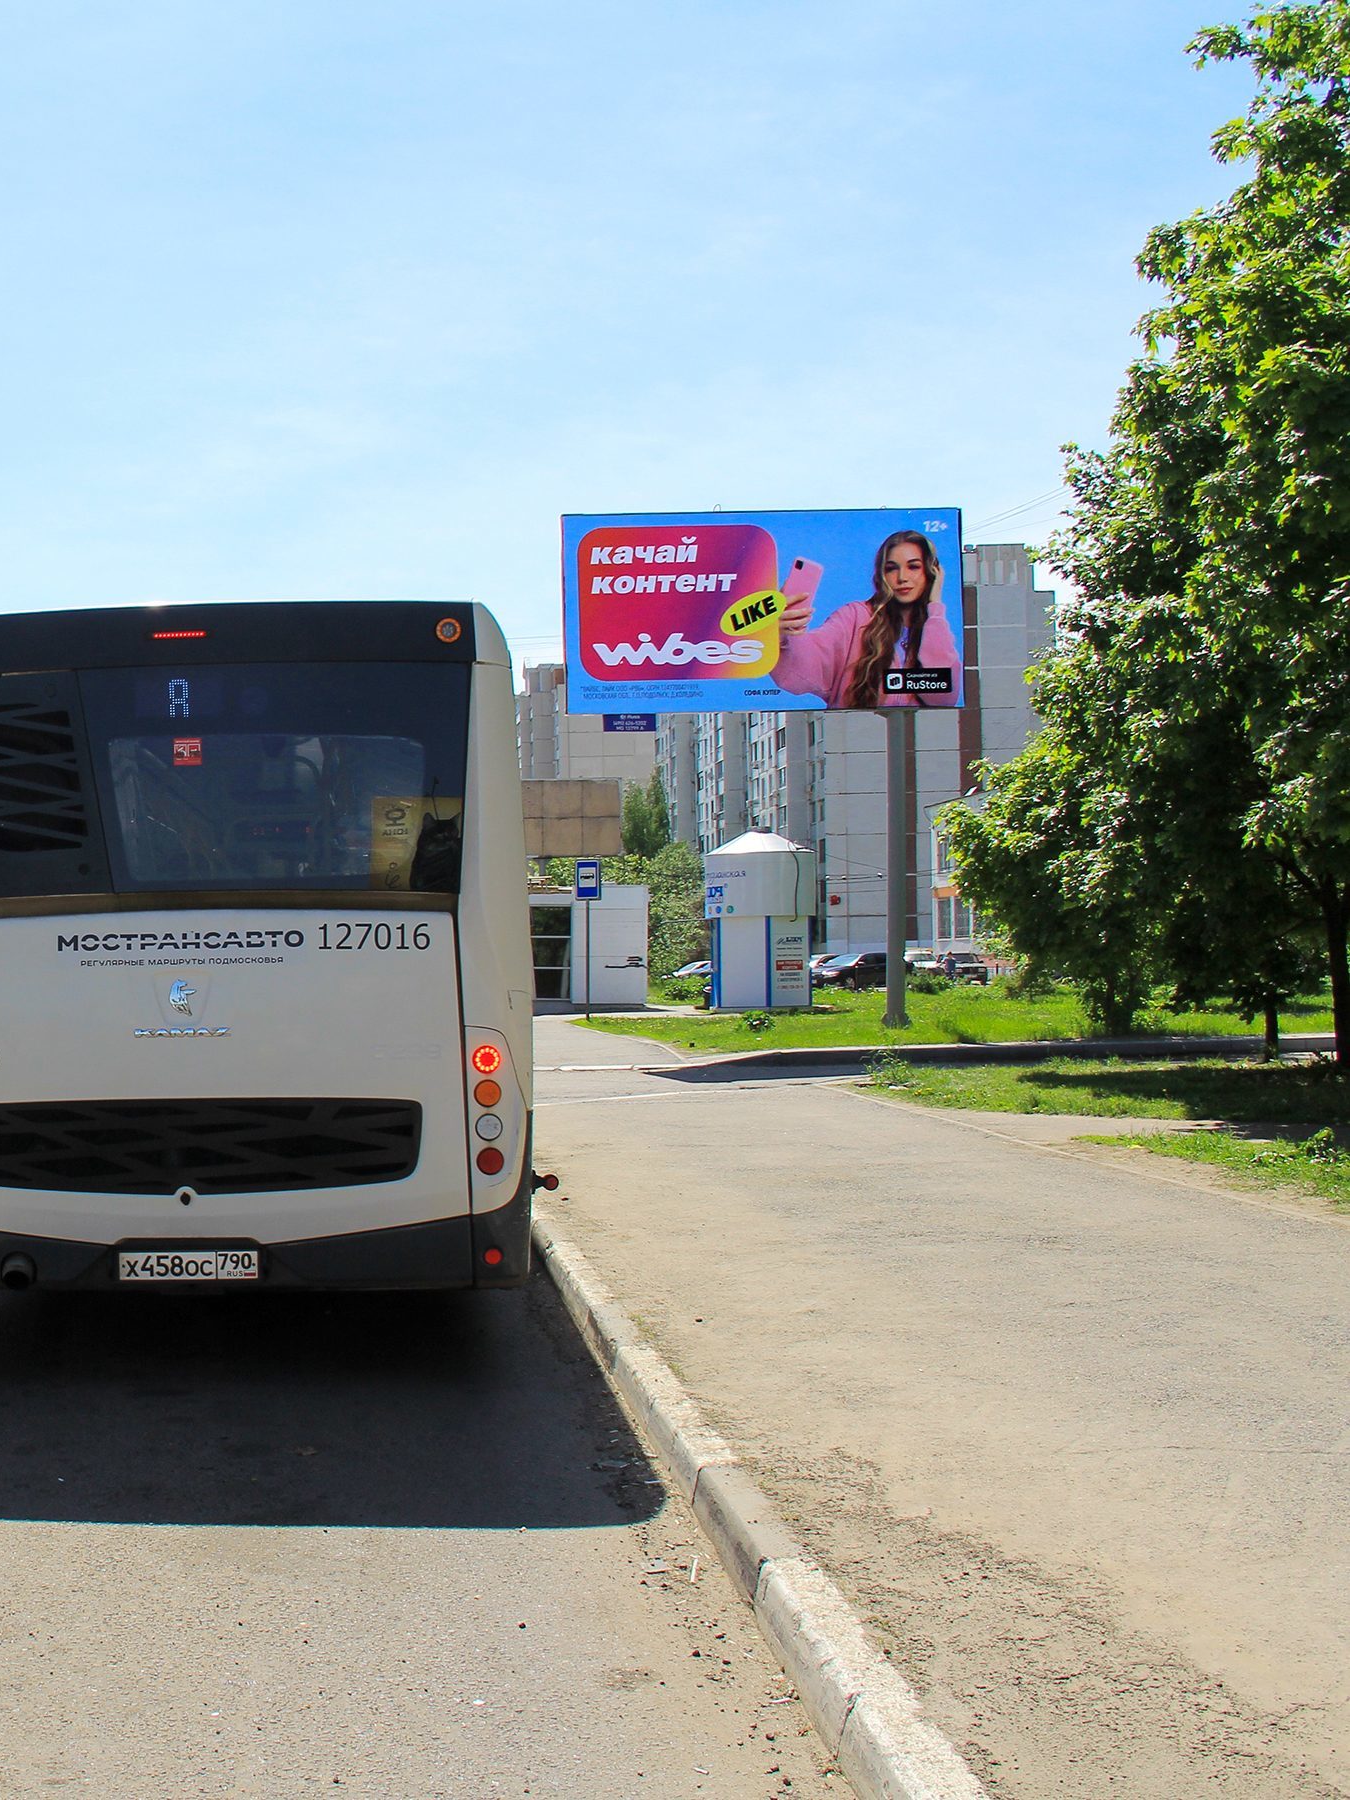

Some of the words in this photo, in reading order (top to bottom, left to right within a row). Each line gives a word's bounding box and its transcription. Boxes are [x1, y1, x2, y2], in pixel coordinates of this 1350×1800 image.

[590, 536, 697, 565] качай
[591, 572, 737, 595] контент
[730, 594, 778, 632] LIKE
[906, 680, 948, 690] RuStore
[57, 929, 305, 952] МОСТРАНСАВТО
[317, 923, 431, 951] 127016
[80, 959, 145, 967] РЕГУЛЯРНЫЕ
[148, 958, 206, 966] МАРШРУТЫ
[208, 956, 284, 965] ПОДМОСКОВЬЯ
[134, 1027, 231, 1039] KAMAZ
[218, 1253, 252, 1270] 790
